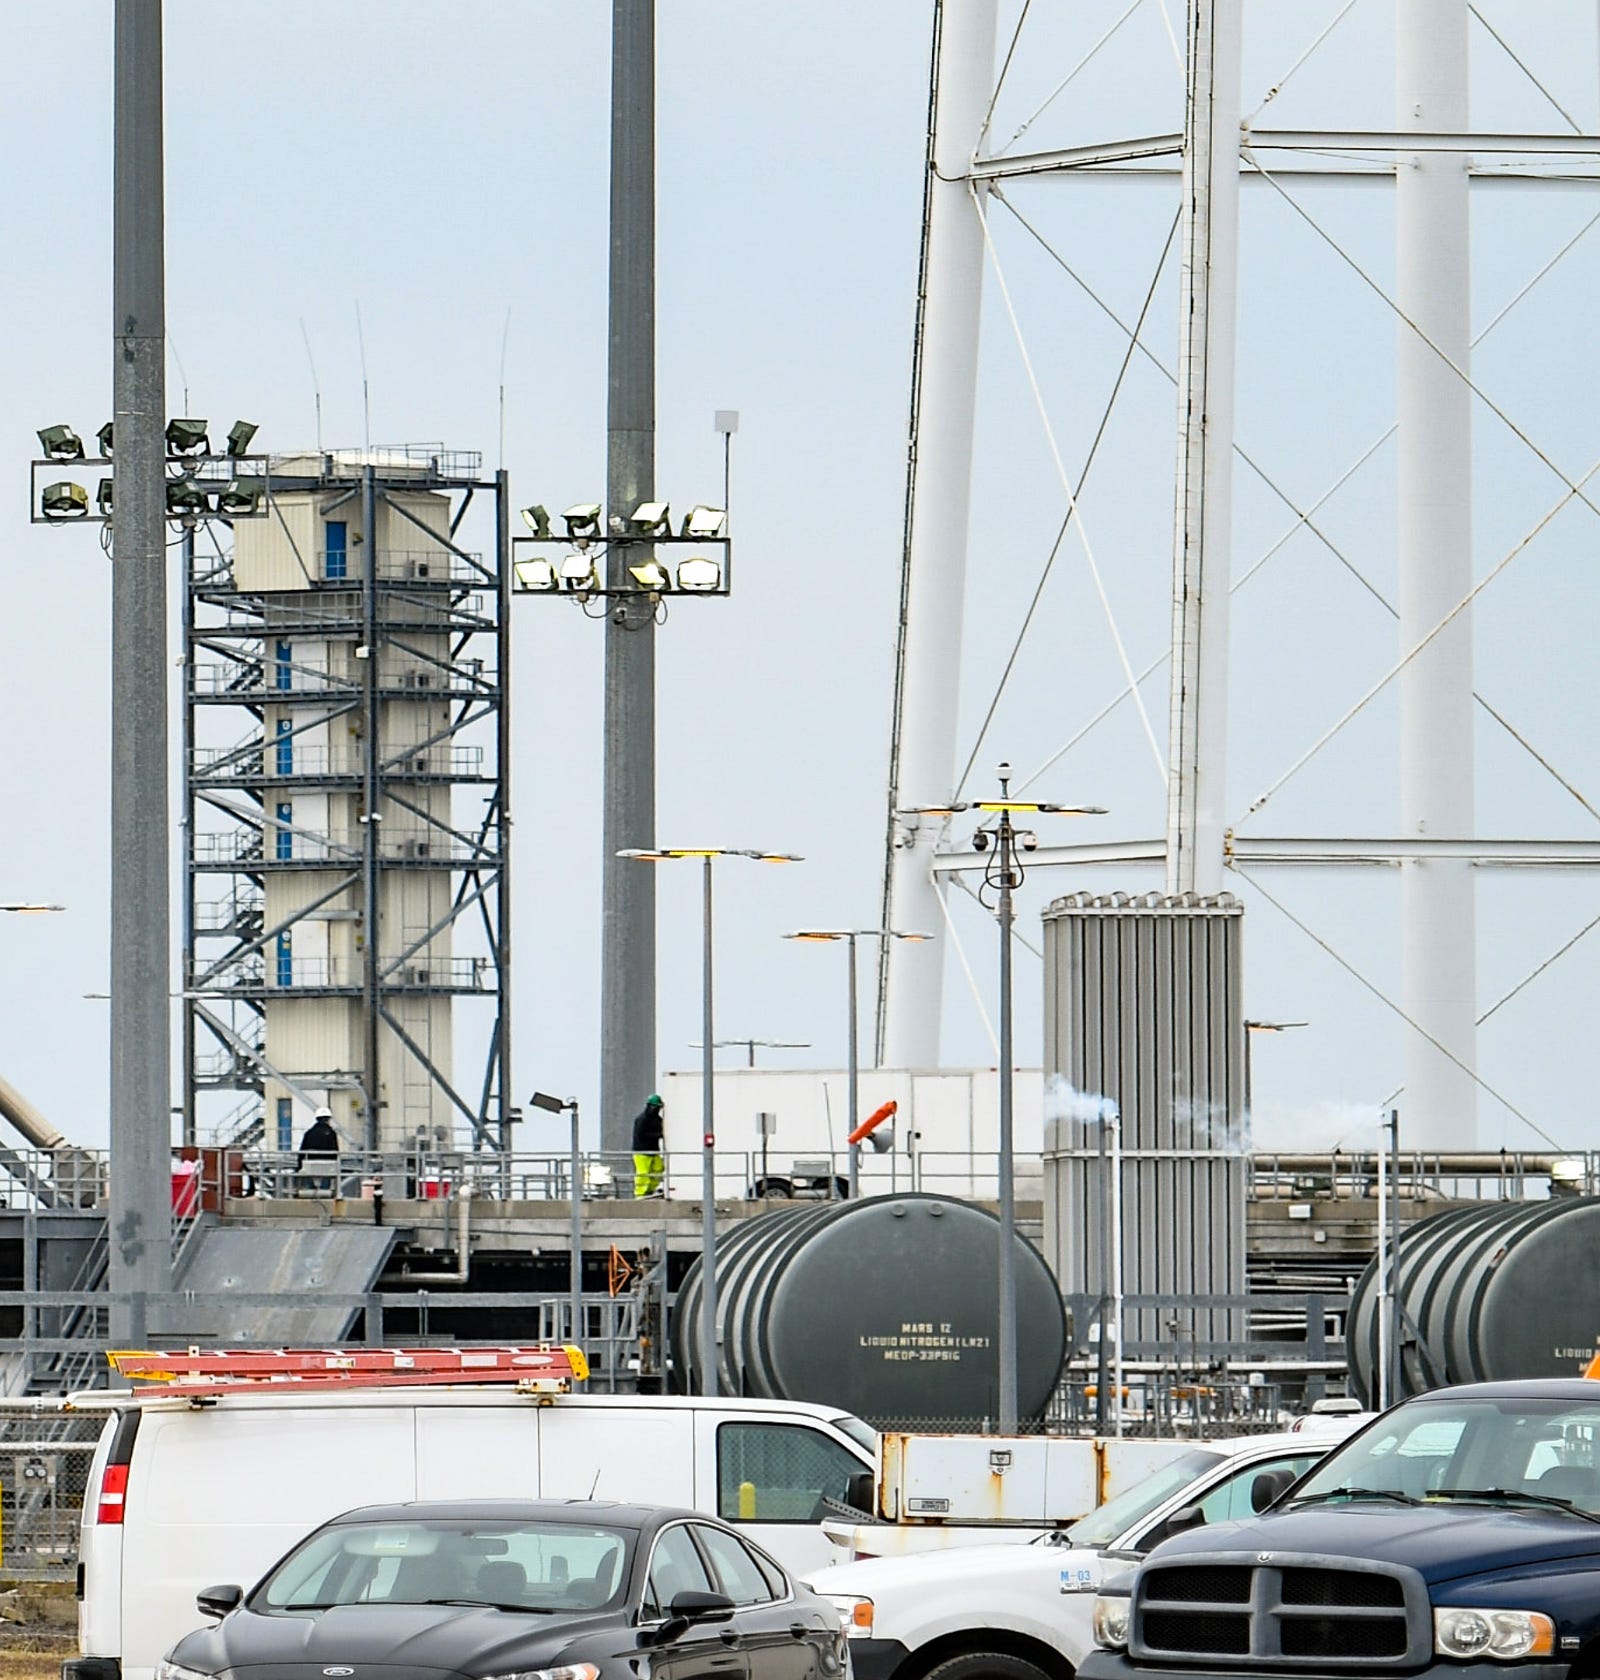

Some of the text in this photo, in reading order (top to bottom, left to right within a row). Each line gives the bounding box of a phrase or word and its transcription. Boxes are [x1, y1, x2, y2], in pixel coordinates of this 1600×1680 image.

[902, 1323, 933, 1333] MARS
[860, 1336, 898, 1346] LIQUID
[1555, 1347, 1593, 1359] LIQUID
[1060, 1570, 1091, 1581] M-03
